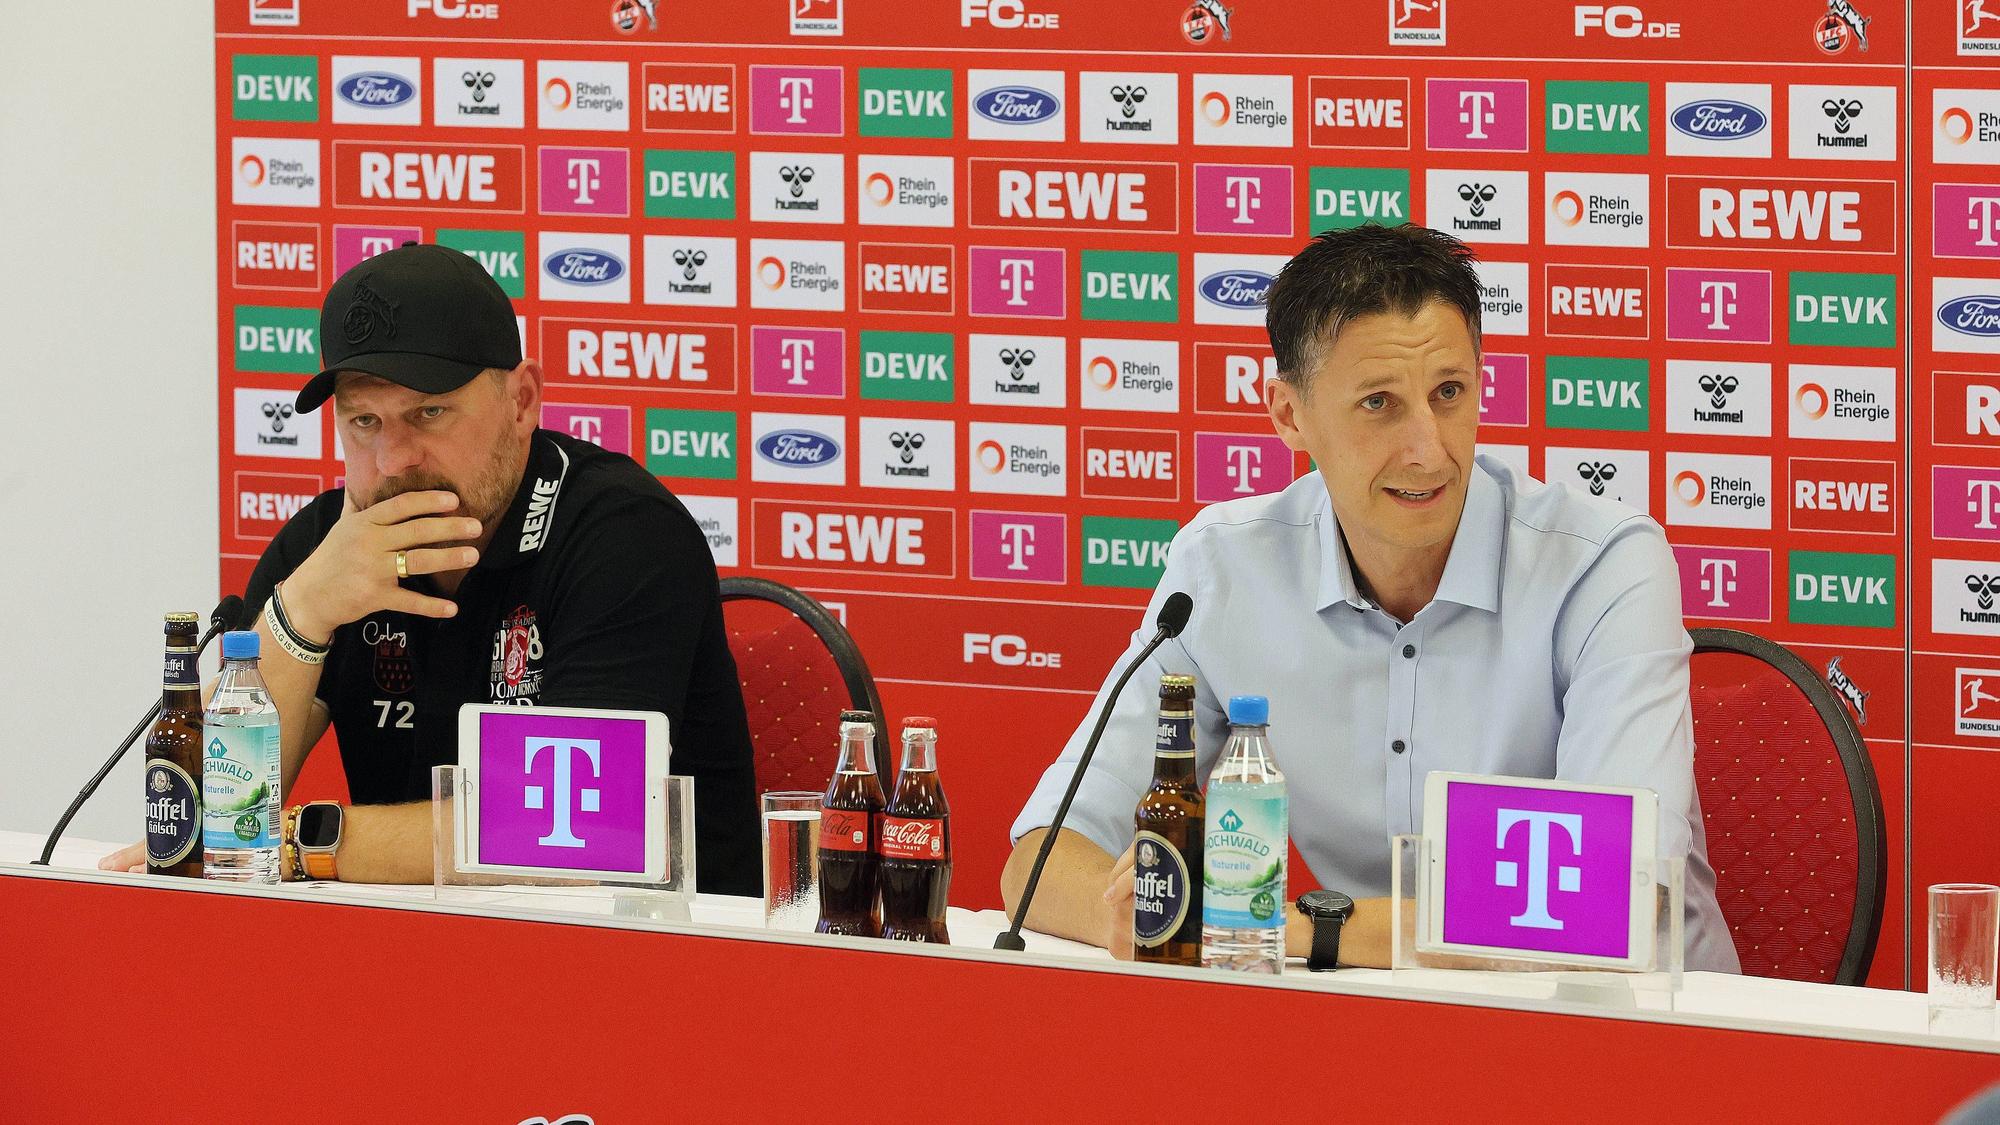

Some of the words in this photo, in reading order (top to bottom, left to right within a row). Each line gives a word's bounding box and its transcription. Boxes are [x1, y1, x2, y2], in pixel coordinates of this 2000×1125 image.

[407, 0, 499, 20] FC.DE
[961, 0, 1059, 29] FC.DE
[1574, 5, 1680, 38] FC.DE
[1394, 32, 1441, 41] BUNDESLIGA
[238, 74, 312, 102] DEVK
[350, 75, 400, 104] Ford
[576, 82, 611, 95] Rhein
[648, 84, 729, 112] REWE
[779, 77, 814, 124] T
[458, 103, 500, 115] hummel
[576, 96, 623, 111] Energie
[864, 88, 946, 117] DEVK
[989, 92, 1044, 119] Ford
[1236, 96, 1274, 111] Rhein
[1315, 98, 1404, 128] REWE
[1458, 91, 1495, 139] T
[1106, 118, 1152, 132] hummel
[1236, 111, 1287, 128] Energie
[1552, 103, 1641, 133] DEVK
[1690, 106, 1747, 134] Ford
[1817, 133, 1868, 148] hummel
[269, 159, 303, 171] Rhein
[359, 152, 496, 202] REWE
[269, 173, 314, 188] Energie
[567, 158, 600, 205] T
[649, 171, 729, 199] DEVK
[899, 177, 935, 191] Rhein
[775, 198, 819, 211] hummel
[899, 191, 948, 207] Energie
[999, 170, 1147, 221] REWE
[1226, 176, 1260, 224] T
[1316, 189, 1402, 218] DEVK
[1589, 196, 1629, 210] Rhein
[1453, 217, 1501, 231] hummel
[1589, 211, 1643, 227] Energie
[1700, 188, 1861, 242] REWE
[238, 241, 314, 271] REWE
[558, 255, 608, 280] Ford
[791, 261, 826, 275] Rhein
[668, 281, 711, 294] hummel
[791, 276, 839, 291] Energie
[865, 263, 948, 295] REWE
[1000, 259, 1034, 306] T
[1087, 271, 1171, 301] DEVK
[1480, 300, 1523, 315] nergie
[1552, 286, 1642, 317] REWE
[1700, 281, 1737, 330] T
[1796, 295, 1888, 325] DEVK
[239, 326, 314, 354] DEVK
[568, 330, 708, 381] REWE
[781, 339, 814, 385] T
[865, 352, 947, 381] DEVK
[1122, 361, 1160, 375] Rhein
[995, 381, 1040, 394] hummel
[1122, 376, 1173, 392] Energie
[1552, 378, 1641, 409] DEVK
[1834, 389, 1875, 403] Rhein
[1694, 408, 1743, 423] hummel
[1834, 404, 1890, 421] Energie
[258, 433, 298, 446] hummel
[651, 429, 730, 458] DEVK
[772, 434, 823, 461] Ford
[1011, 446, 1047, 459] Rhein
[885, 465, 929, 477] hummel
[1011, 460, 1060, 476] Energie
[1087, 449, 1172, 479] REWE
[1226, 445, 1261, 493] T
[1711, 477, 1751, 491] Rhein
[1796, 480, 1888, 512] REWE
[1711, 492, 1765, 508] Energie
[519, 478, 559, 552] REWE
[781, 511, 925, 566] REWE
[1001, 524, 1035, 570] T
[1088, 538, 1170, 567] DEVK
[1700, 559, 1737, 608] T
[1796, 574, 1887, 605] DEVK
[1961, 608, 2000, 623] humm
[266, 609, 285, 642] ERFOLG
[284, 640, 297, 654] IST
[297, 652, 320, 663] KEIN
[963, 633, 1061, 668] FC.DE
[373, 700, 415, 729] 72
[1960, 722, 2000, 732] BUNDESLI
[205, 761, 253, 782] CHWALD
[524, 736, 601, 848] T
[1495, 808, 1583, 930] T
